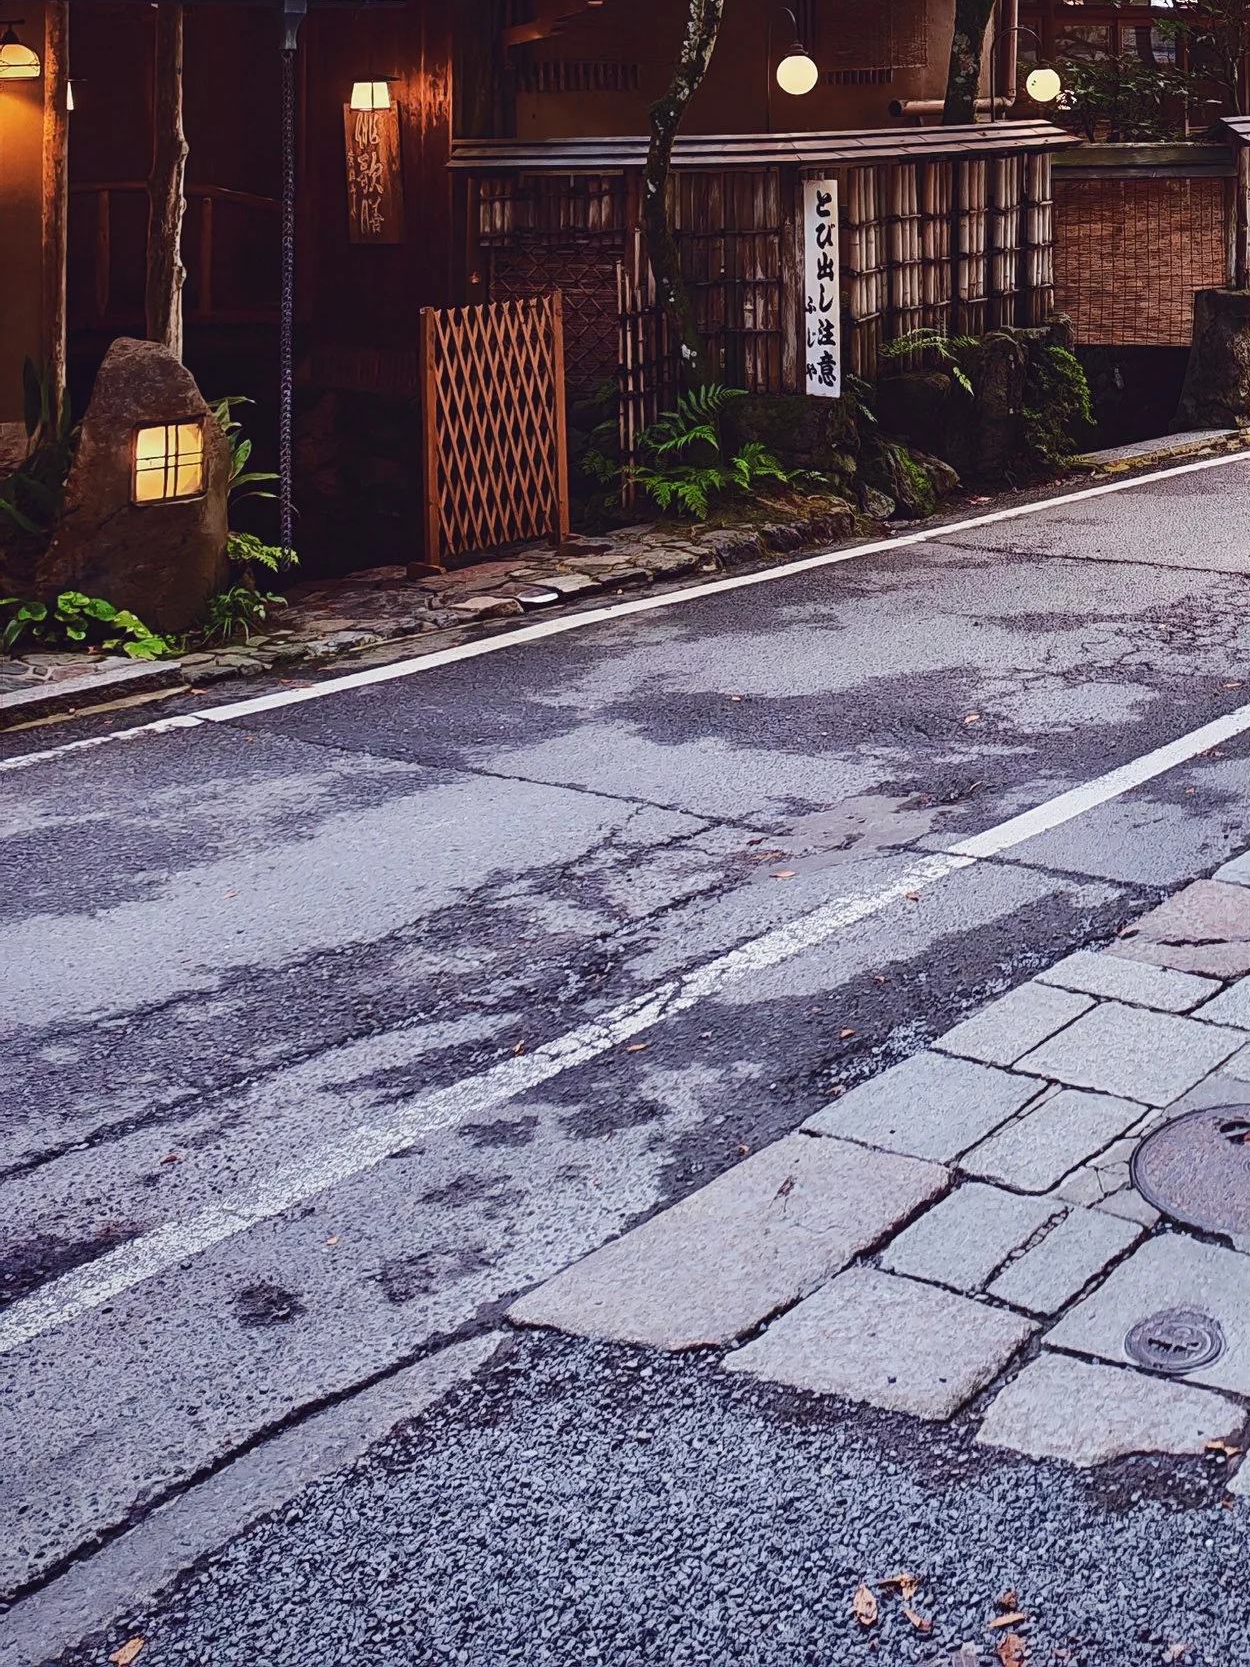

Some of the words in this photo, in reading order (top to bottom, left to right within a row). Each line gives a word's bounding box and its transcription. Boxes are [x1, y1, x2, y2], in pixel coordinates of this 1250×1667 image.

[805, 295, 818, 382] ふじや
[815, 190, 837, 388] とび出し注意
